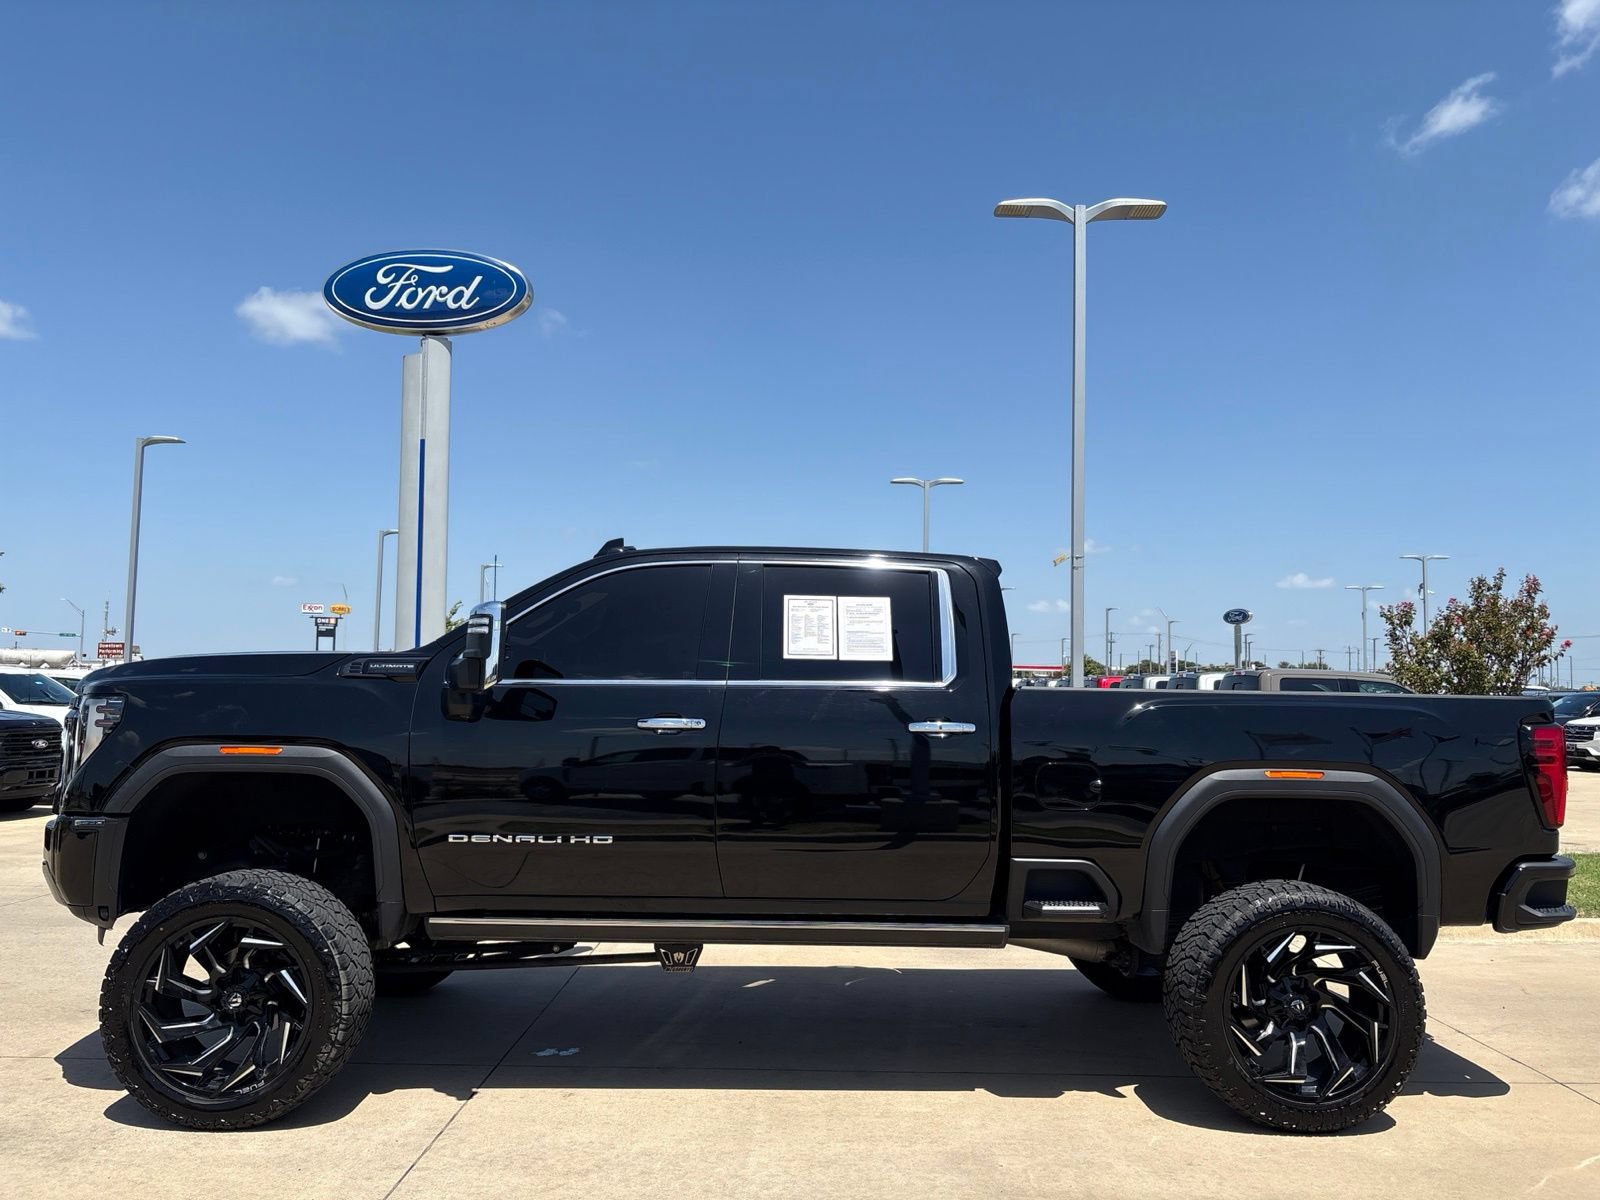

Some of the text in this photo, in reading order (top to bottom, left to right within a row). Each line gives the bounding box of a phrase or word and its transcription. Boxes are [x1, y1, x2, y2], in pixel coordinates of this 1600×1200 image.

[365, 263, 483, 310] Ford
[303, 604, 323, 612] Exxon
[448, 834, 613, 844] DENALI HD
[1371, 959, 1388, 989] FUEL
[234, 1080, 265, 1095] FUEL
